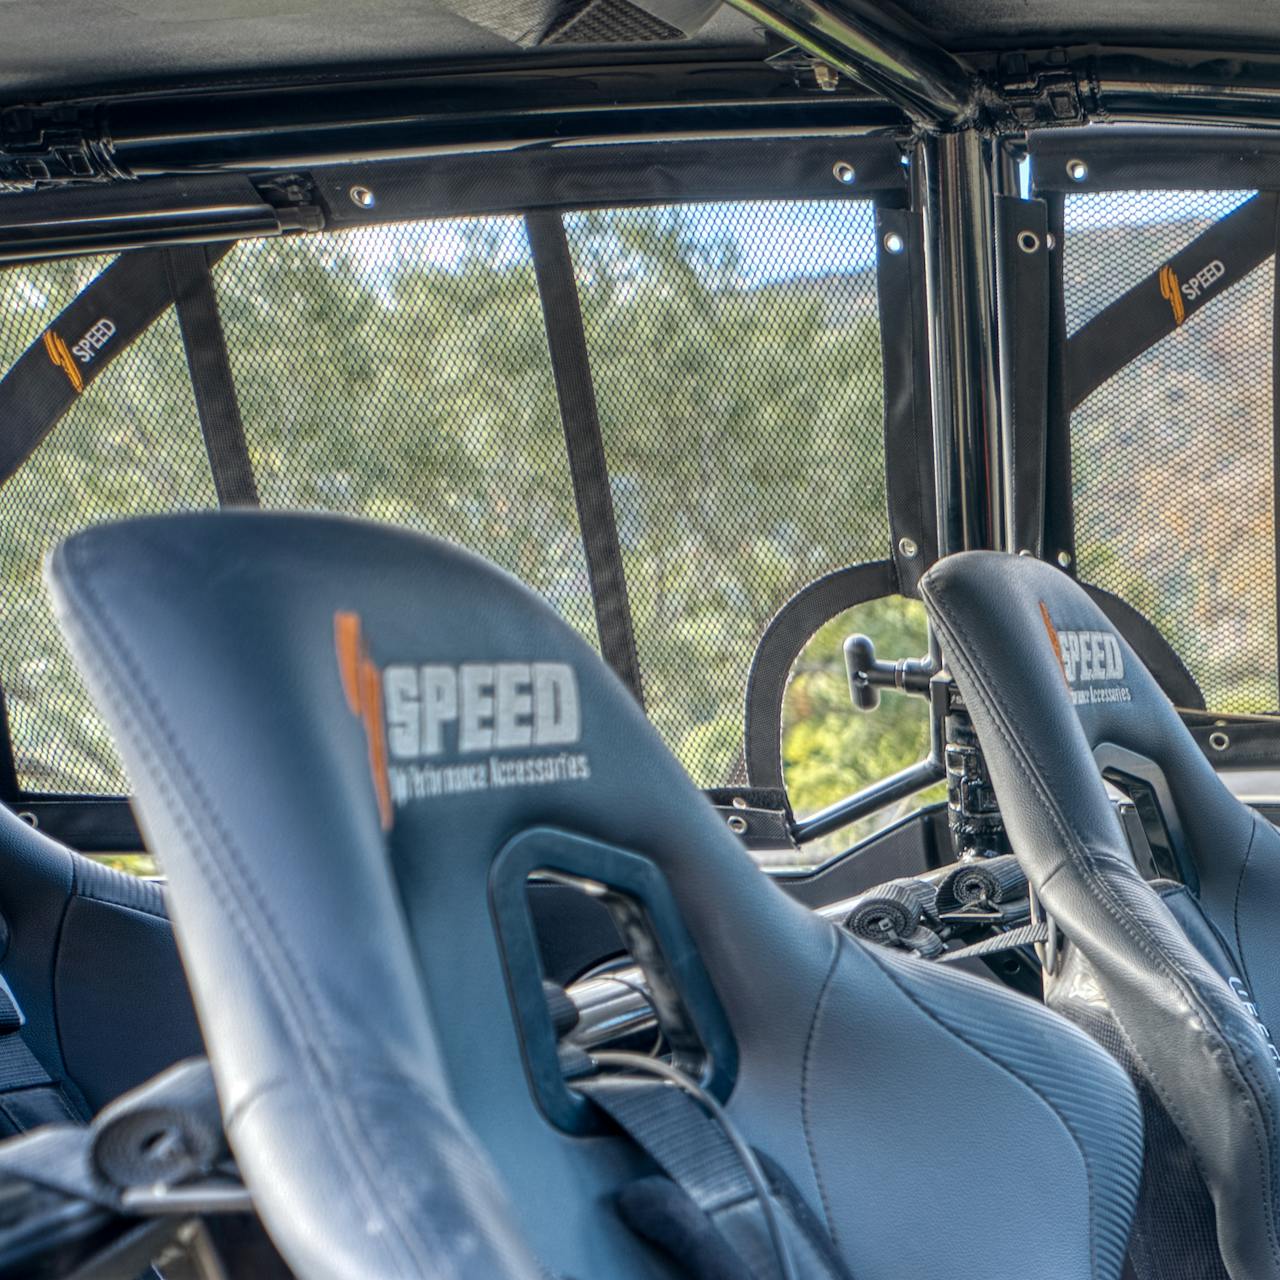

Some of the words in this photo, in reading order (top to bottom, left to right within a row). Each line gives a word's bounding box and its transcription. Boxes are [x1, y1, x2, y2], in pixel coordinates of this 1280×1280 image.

[1181, 260, 1226, 300] SPEED
[71, 318, 117, 362] SPEED
[1057, 629, 1124, 682] SPEED
[383, 661, 582, 759] SPEED
